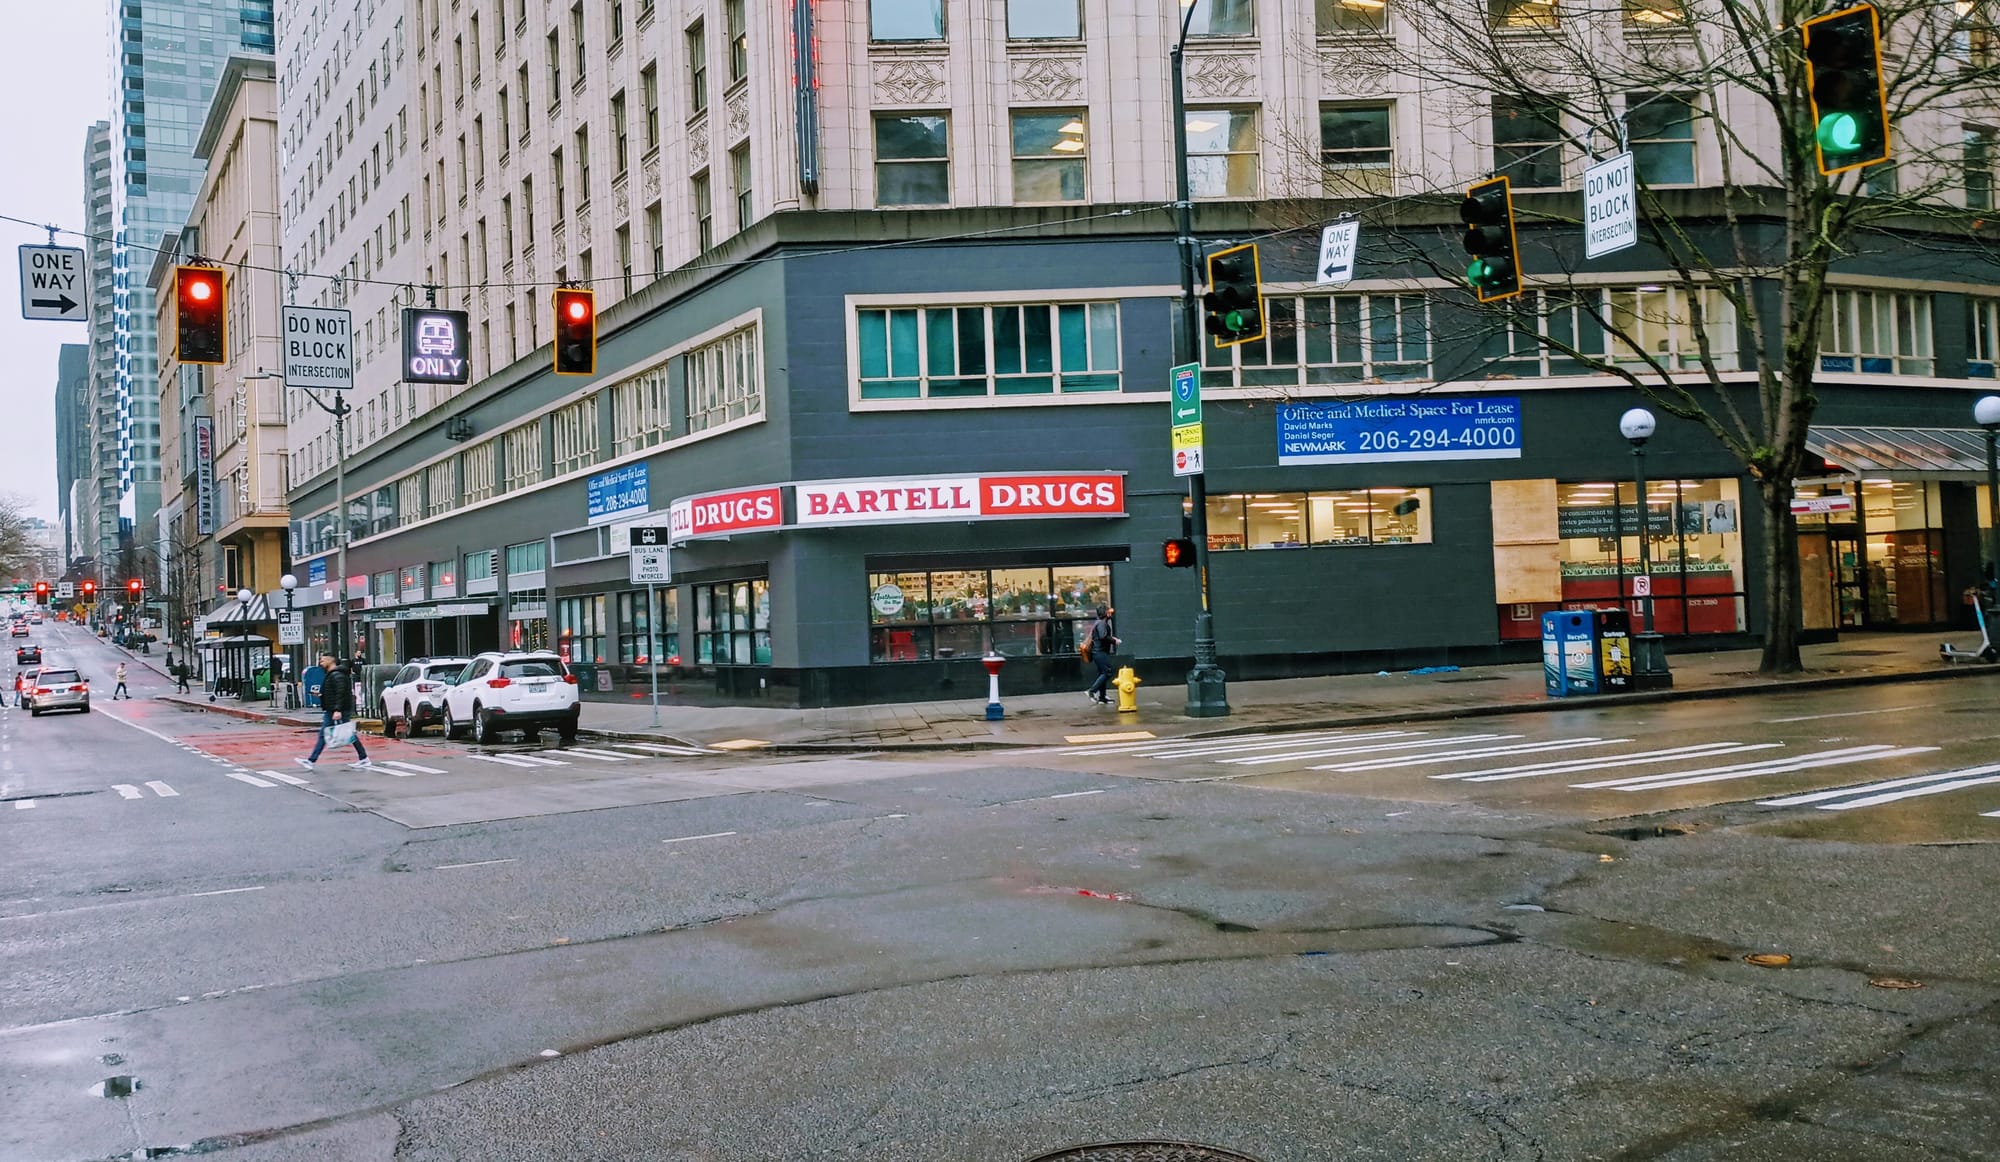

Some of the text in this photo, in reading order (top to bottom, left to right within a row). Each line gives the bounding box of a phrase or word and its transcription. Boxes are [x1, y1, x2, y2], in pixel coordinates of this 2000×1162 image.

[1588, 166, 1629, 197] DO NOT
[1590, 193, 1630, 223] BLOCK
[1328, 228, 1351, 244] ONE
[1590, 219, 1633, 245] INTERSECTION
[1326, 244, 1350, 260] WAY
[32, 253, 74, 270] ONE
[31, 272, 76, 290] WAY
[288, 316, 347, 335] DO NOT
[290, 340, 346, 359] BLOCK
[288, 364, 350, 379] INTERSECTION
[411, 357, 462, 376] ONLY
[1181, 381, 1189, 396] 5
[1283, 401, 1514, 420] Office and Medical Space For Lease
[1308, 422, 1333, 430] Marks
[1474, 416, 1515, 424] nmrk.com
[1284, 431, 1335, 441] Daniel Seger
[1359, 426, 1516, 450] 206-294-4000
[1284, 441, 1346, 453] NEWMARK
[605, 487, 648, 512] 206-294-4000
[806, 482, 1116, 516] BARTELL DRUGS
[694, 495, 774, 527] DRUGS
[1207, 535, 1240, 543] Checkout
[648, 546, 664, 554] LANE
[1516, 603, 1530, 617] B
[1566, 633, 1588, 641] Recycle
